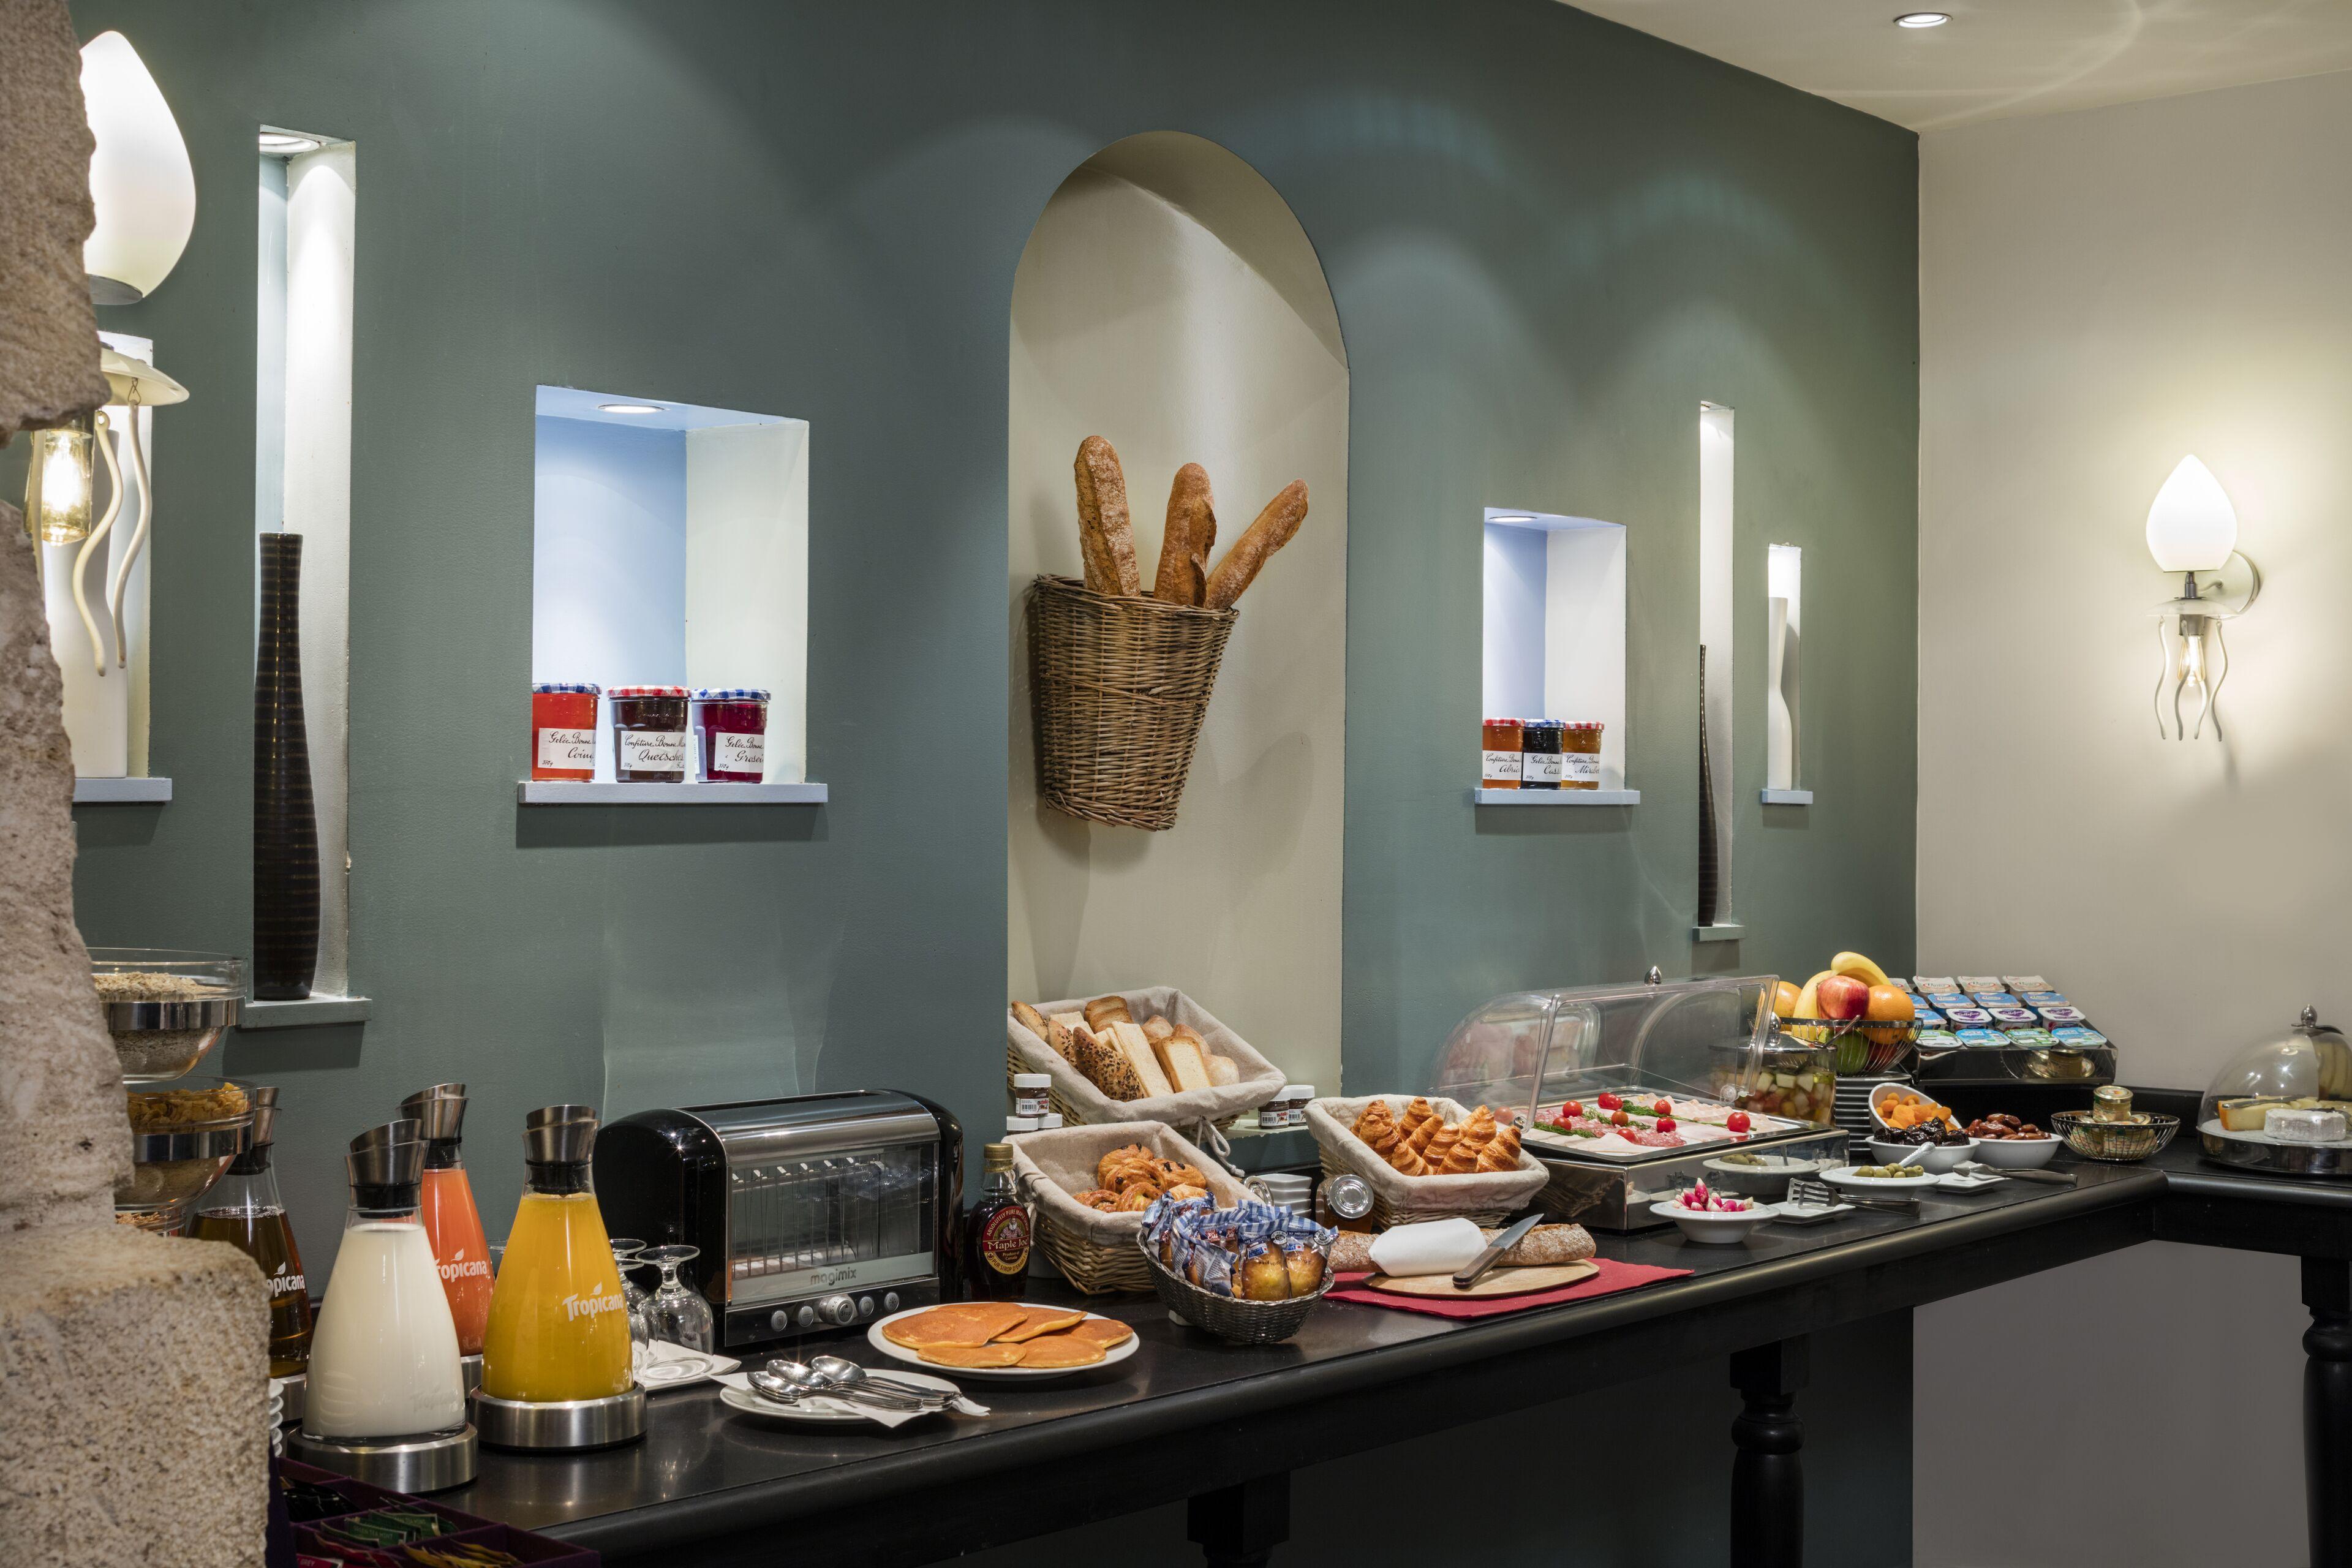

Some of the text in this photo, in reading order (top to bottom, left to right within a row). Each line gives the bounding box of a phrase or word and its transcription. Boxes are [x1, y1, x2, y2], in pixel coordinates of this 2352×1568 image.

[625, 734, 654, 748] Confiture
[655, 735, 676, 747] Bonne
[735, 750, 764, 763] Grosei
[986, 1212, 1006, 1237] ABSOLUTELY
[987, 1238, 1028, 1251] Maple Joe
[991, 1259, 1001, 1268] PUR
[810, 1267, 857, 1286] magimix
[266, 1274, 306, 1297] opicana
[562, 1293, 624, 1322] Tropicana
